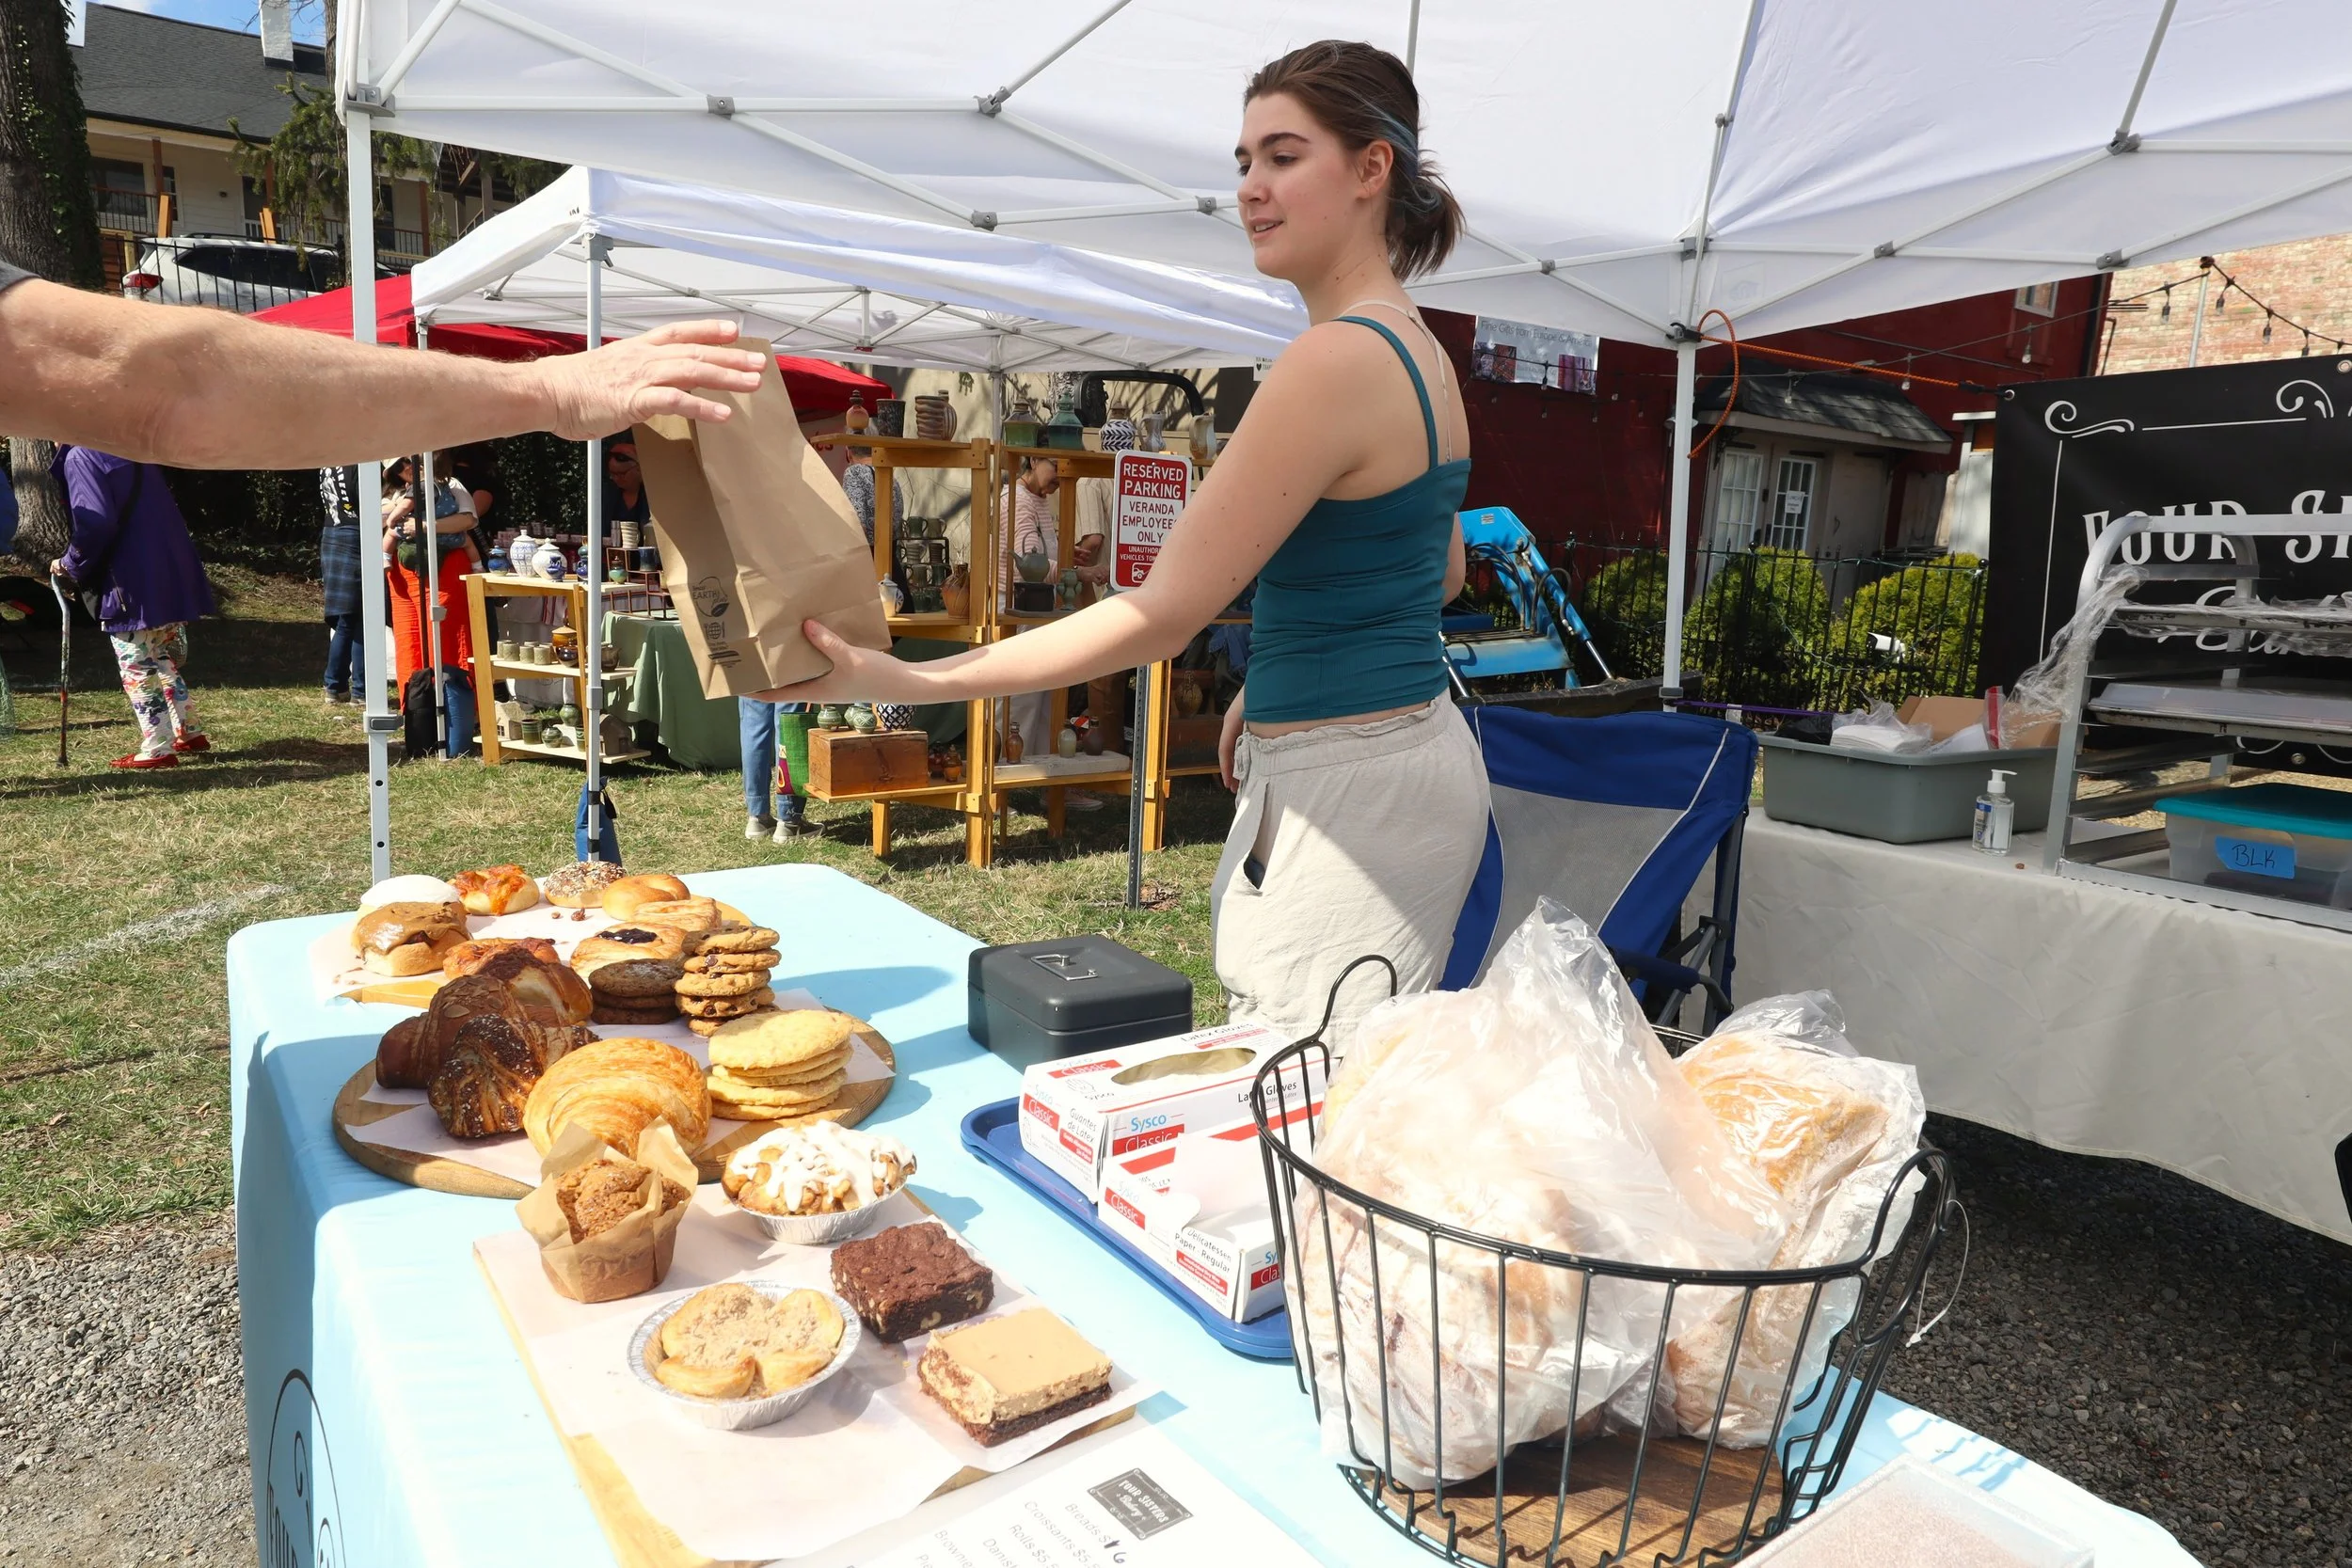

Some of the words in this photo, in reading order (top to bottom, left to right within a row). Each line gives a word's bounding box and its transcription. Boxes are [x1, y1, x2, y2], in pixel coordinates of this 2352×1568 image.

[1481, 321, 1497, 332] Fine
[1499, 324, 1515, 336] Gifts
[1516, 326, 1532, 338] from
[1534, 329, 1559, 341] Europe
[1123, 463, 1184, 482] RESERVED
[1124, 480, 1181, 499] PARKING
[1129, 501, 1174, 515] VERANDA
[1122, 515, 1177, 530] EMPLOYEE
[1137, 531, 1164, 543] ONLY
[1128, 546, 1162, 554] UNAUTHOR
[2232, 844, 2275, 869] BLK
[1061, 1062, 1108, 1076] Classic
[1265, 1082, 1297, 1096] Glves
[1029, 1099, 1055, 1128] Classic
[1070, 1107, 1097, 1132] Guantes
[1131, 1114, 1168, 1133] Sysco
[1126, 1131, 1173, 1154] Classic
[1111, 1194, 1138, 1225] Classic
[1175, 1232, 1197, 1252] Paper
[1201, 1248, 1231, 1274] Regular
[1187, 1228, 1232, 1263] Delicatessen
[1065, 1503, 1101, 1536] Breads
[1138, 1495, 1169, 1523] SISTERS
[1009, 1524, 1036, 1550] Rolls
[1024, 1500, 1075, 1551] Croissants
